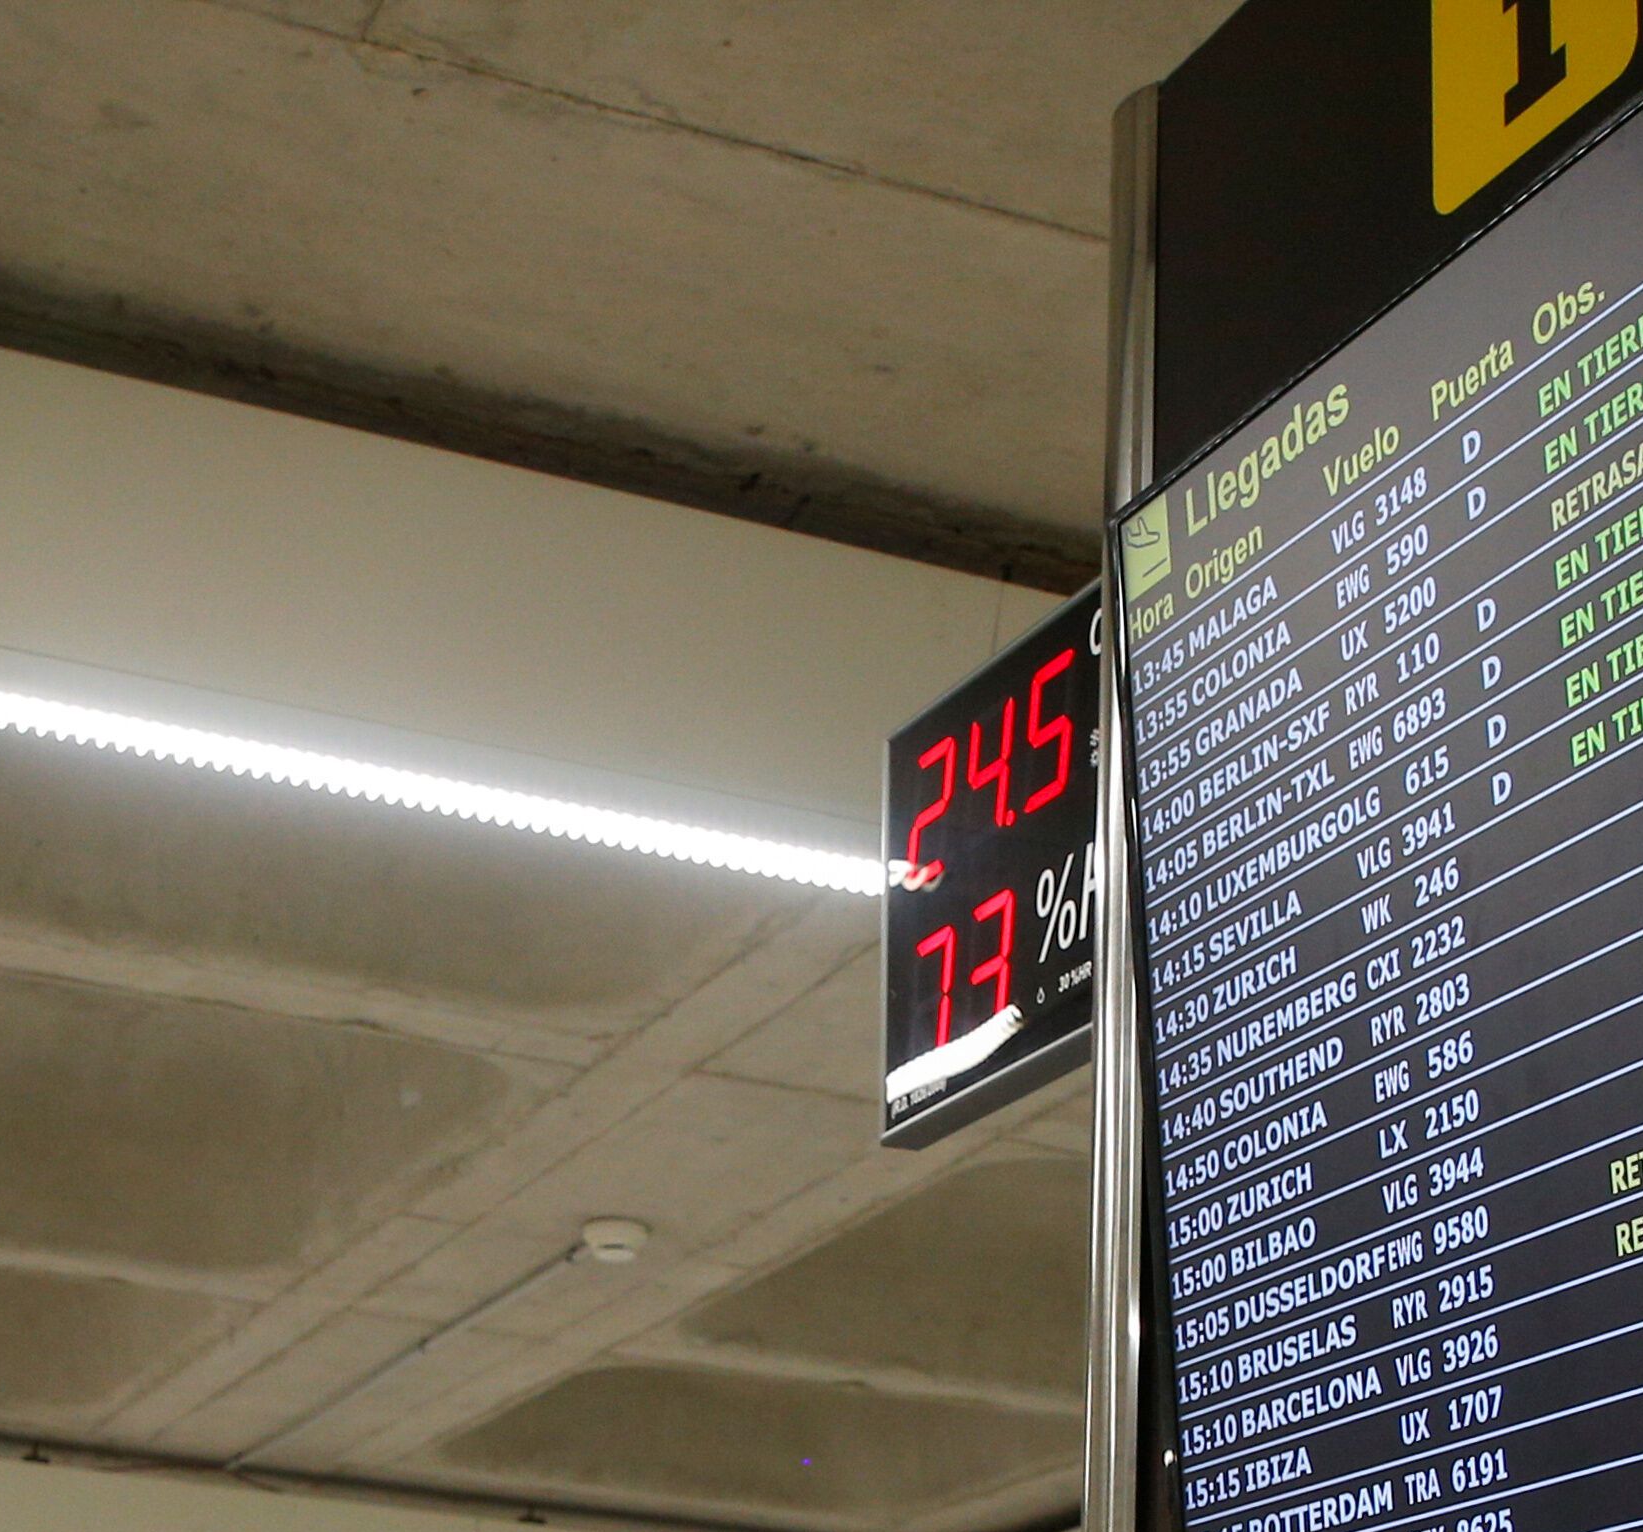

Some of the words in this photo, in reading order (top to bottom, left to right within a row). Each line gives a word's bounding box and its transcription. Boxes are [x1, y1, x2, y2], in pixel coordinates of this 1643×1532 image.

[1129, 593, 1174, 644] Hora
[1185, 525, 1263, 599] Origen
[1322, 426, 1399, 497] Vuelo
[1431, 340, 1514, 421] Puerta
[1532, 281, 1605, 345] Obs.
[1133, 638, 1185, 696] 13:45
[1188, 575, 1278, 658] MALAGA
[1331, 510, 1365, 554] VLG
[1375, 466, 1427, 526] 3148
[1462, 430, 1481, 464] D
[1538, 377, 1573, 415] EN
[1136, 689, 1188, 745] 13:55
[1192, 620, 1291, 706] COLONIA
[1336, 563, 1370, 610] EWG
[1386, 524, 1429, 575] 590
[1467, 486, 1486, 520] D
[1544, 434, 1579, 472] EN
[1186, 384, 1349, 537] Llegadas
[1139, 738, 1191, 794] 13:55
[1195, 667, 1303, 756] GRANADA
[1341, 620, 1369, 661] UX
[1384, 576, 1436, 634] 5200
[1142, 789, 1195, 843] 14:00
[1199, 700, 1330, 808] BERLIN-SXF
[1345, 672, 1380, 716] RYR
[1396, 632, 1440, 683] 110
[1477, 598, 1496, 632] D
[1554, 550, 1589, 588] EN
[1152, 941, 1205, 994] 14:15
[1209, 890, 1302, 963] SEVILLA
[1356, 837, 1392, 879] VLG
[1401, 801, 1456, 856] 3941
[1492, 771, 1512, 806] D
[1570, 725, 1606, 765] EN
[1159, 1045, 1212, 1096] 14:35
[1216, 971, 1357, 1067] NUREMBERG
[1366, 947, 1401, 990] CXI
[1411, 915, 1466, 969] 2232
[1178, 1359, 1234, 1404] 15:10
[1237, 1314, 1357, 1383] BRUSELAS
[1392, 1289, 1429, 1329] RYR
[1438, 1264, 1493, 1313] 2915
